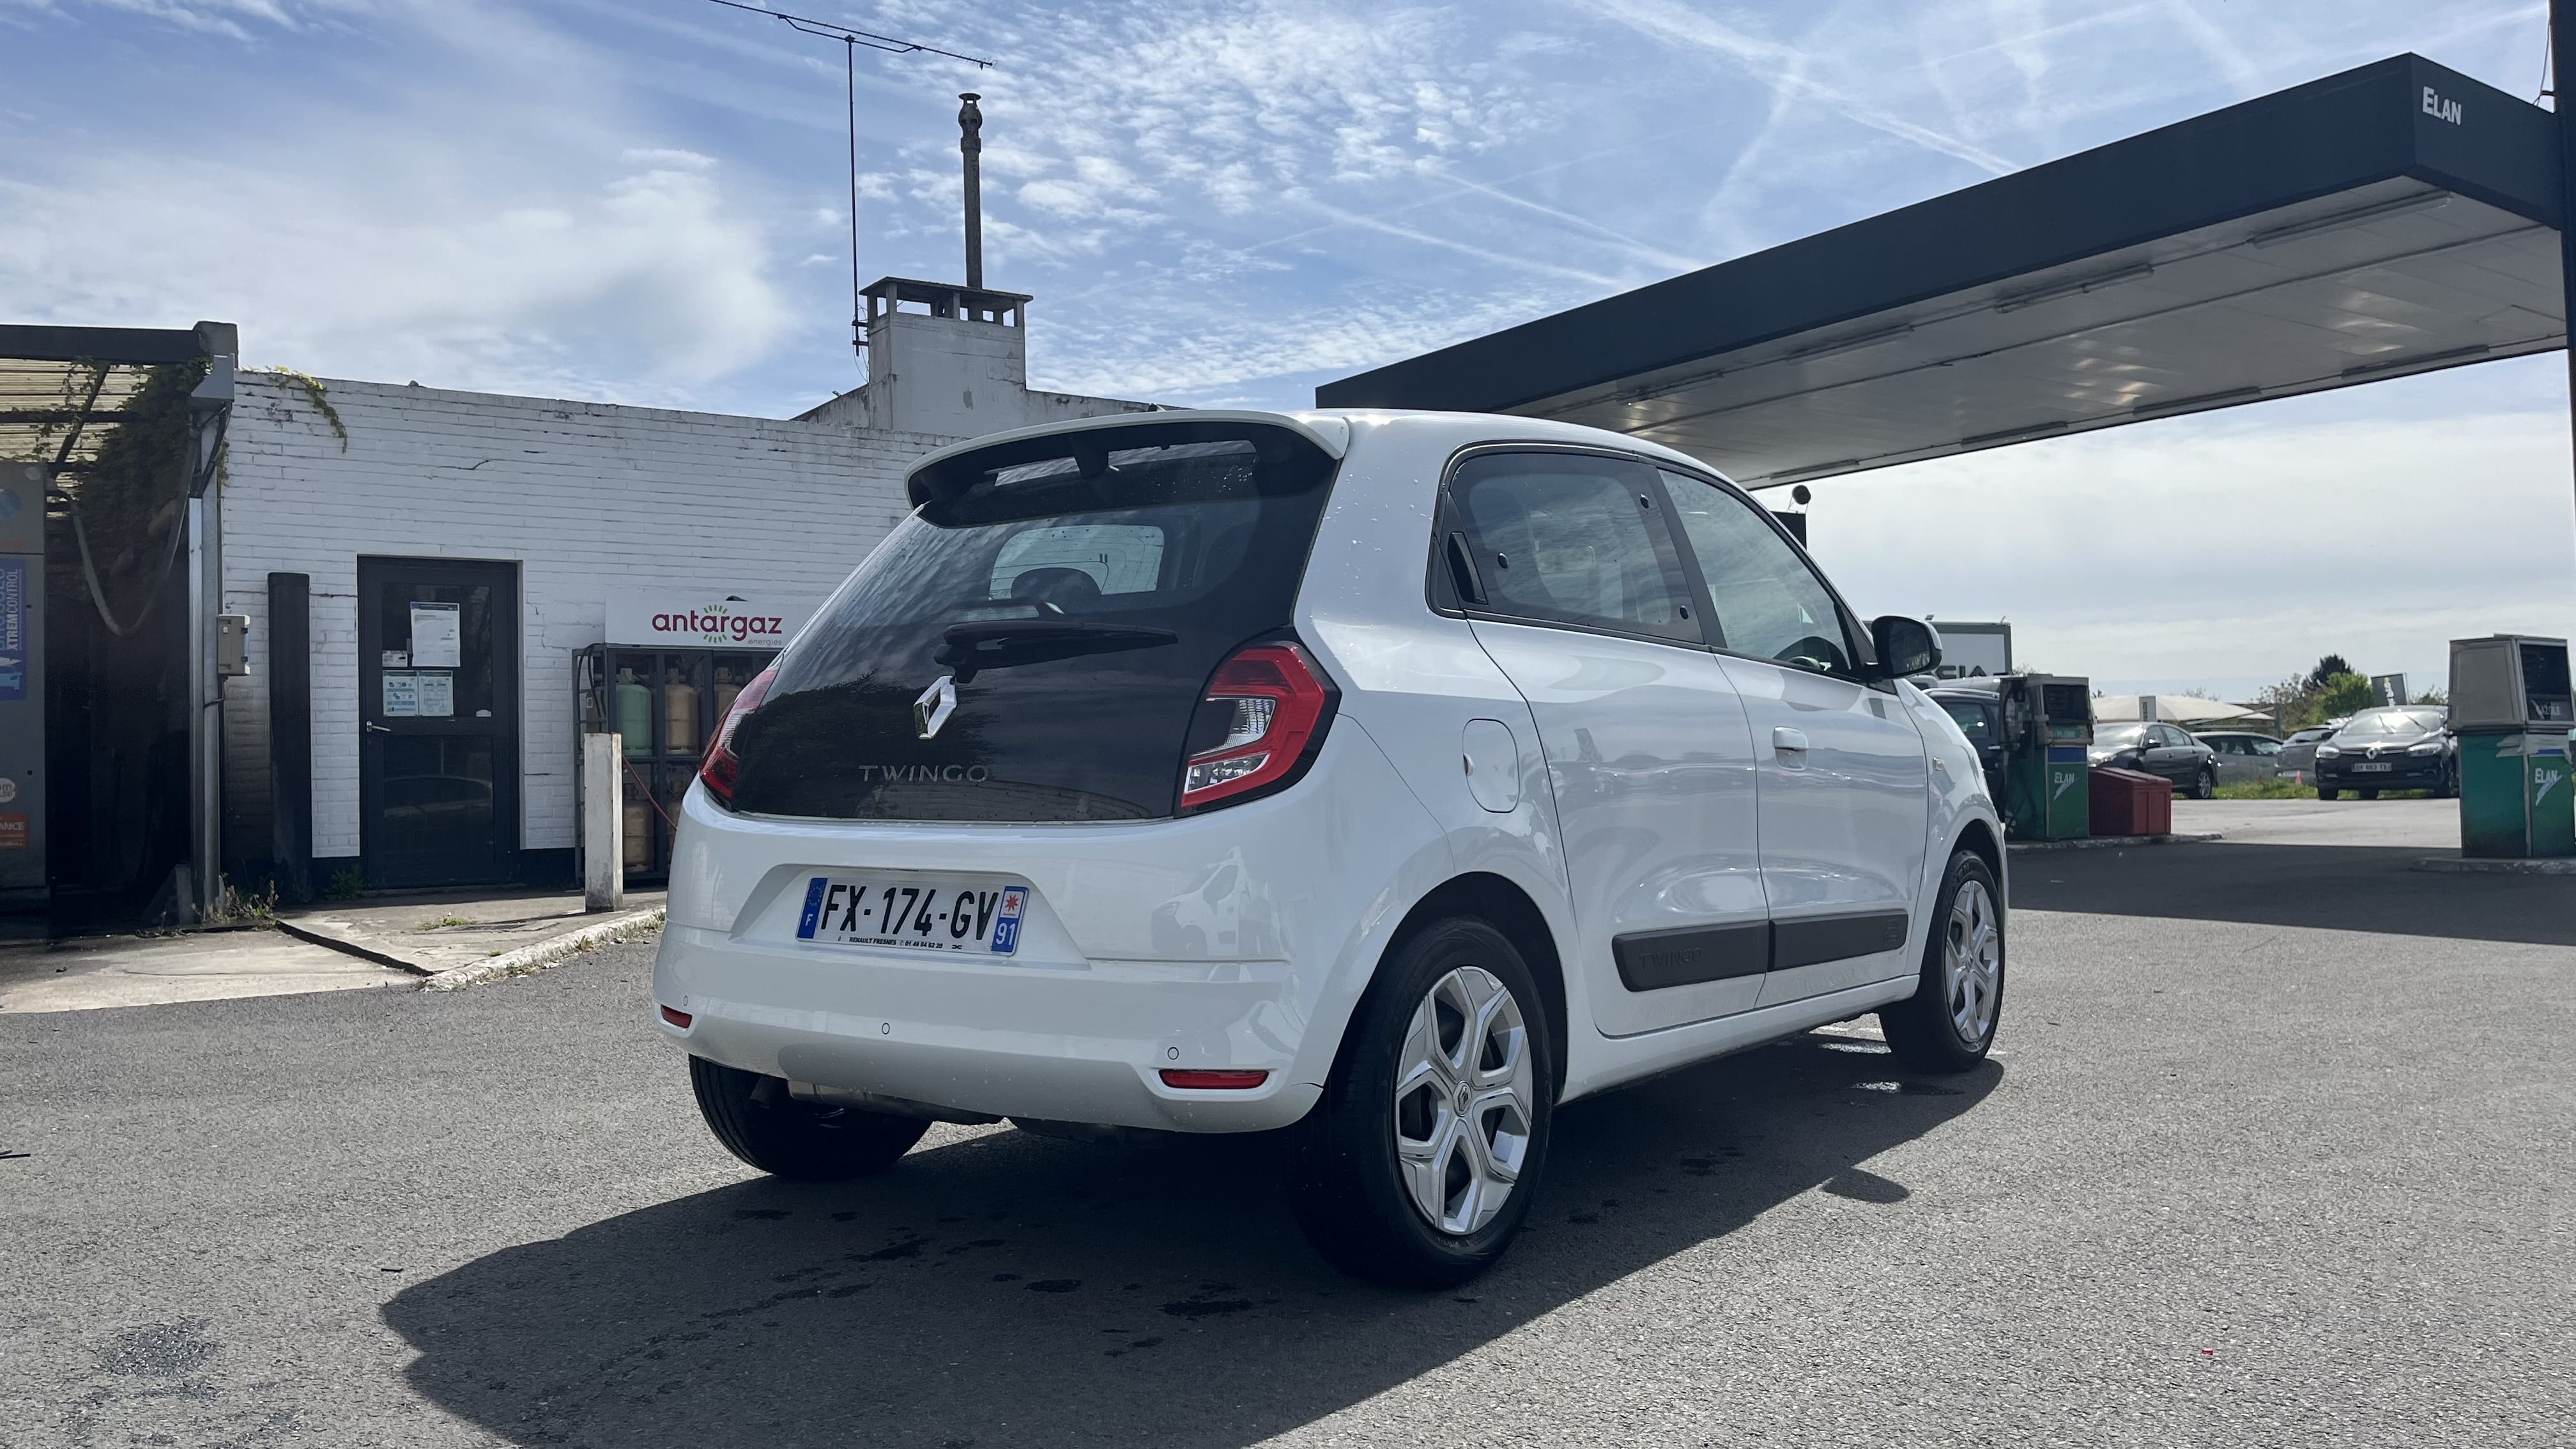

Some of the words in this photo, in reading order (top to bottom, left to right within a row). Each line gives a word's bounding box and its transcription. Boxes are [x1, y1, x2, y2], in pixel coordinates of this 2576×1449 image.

[2422, 86, 2462, 126] ELAN
[652, 610, 783, 641] antargaz
[1935, 665, 1987, 680] CIA
[858, 764, 990, 783] TWINGO
[2054, 772, 2074, 783] ELAN
[2534, 767, 2558, 784] ELAN
[805, 914, 813, 926] F
[820, 884, 999, 940] FX-174-GV
[995, 922, 1016, 946] 91
[1639, 947, 1702, 971] TWINGO
